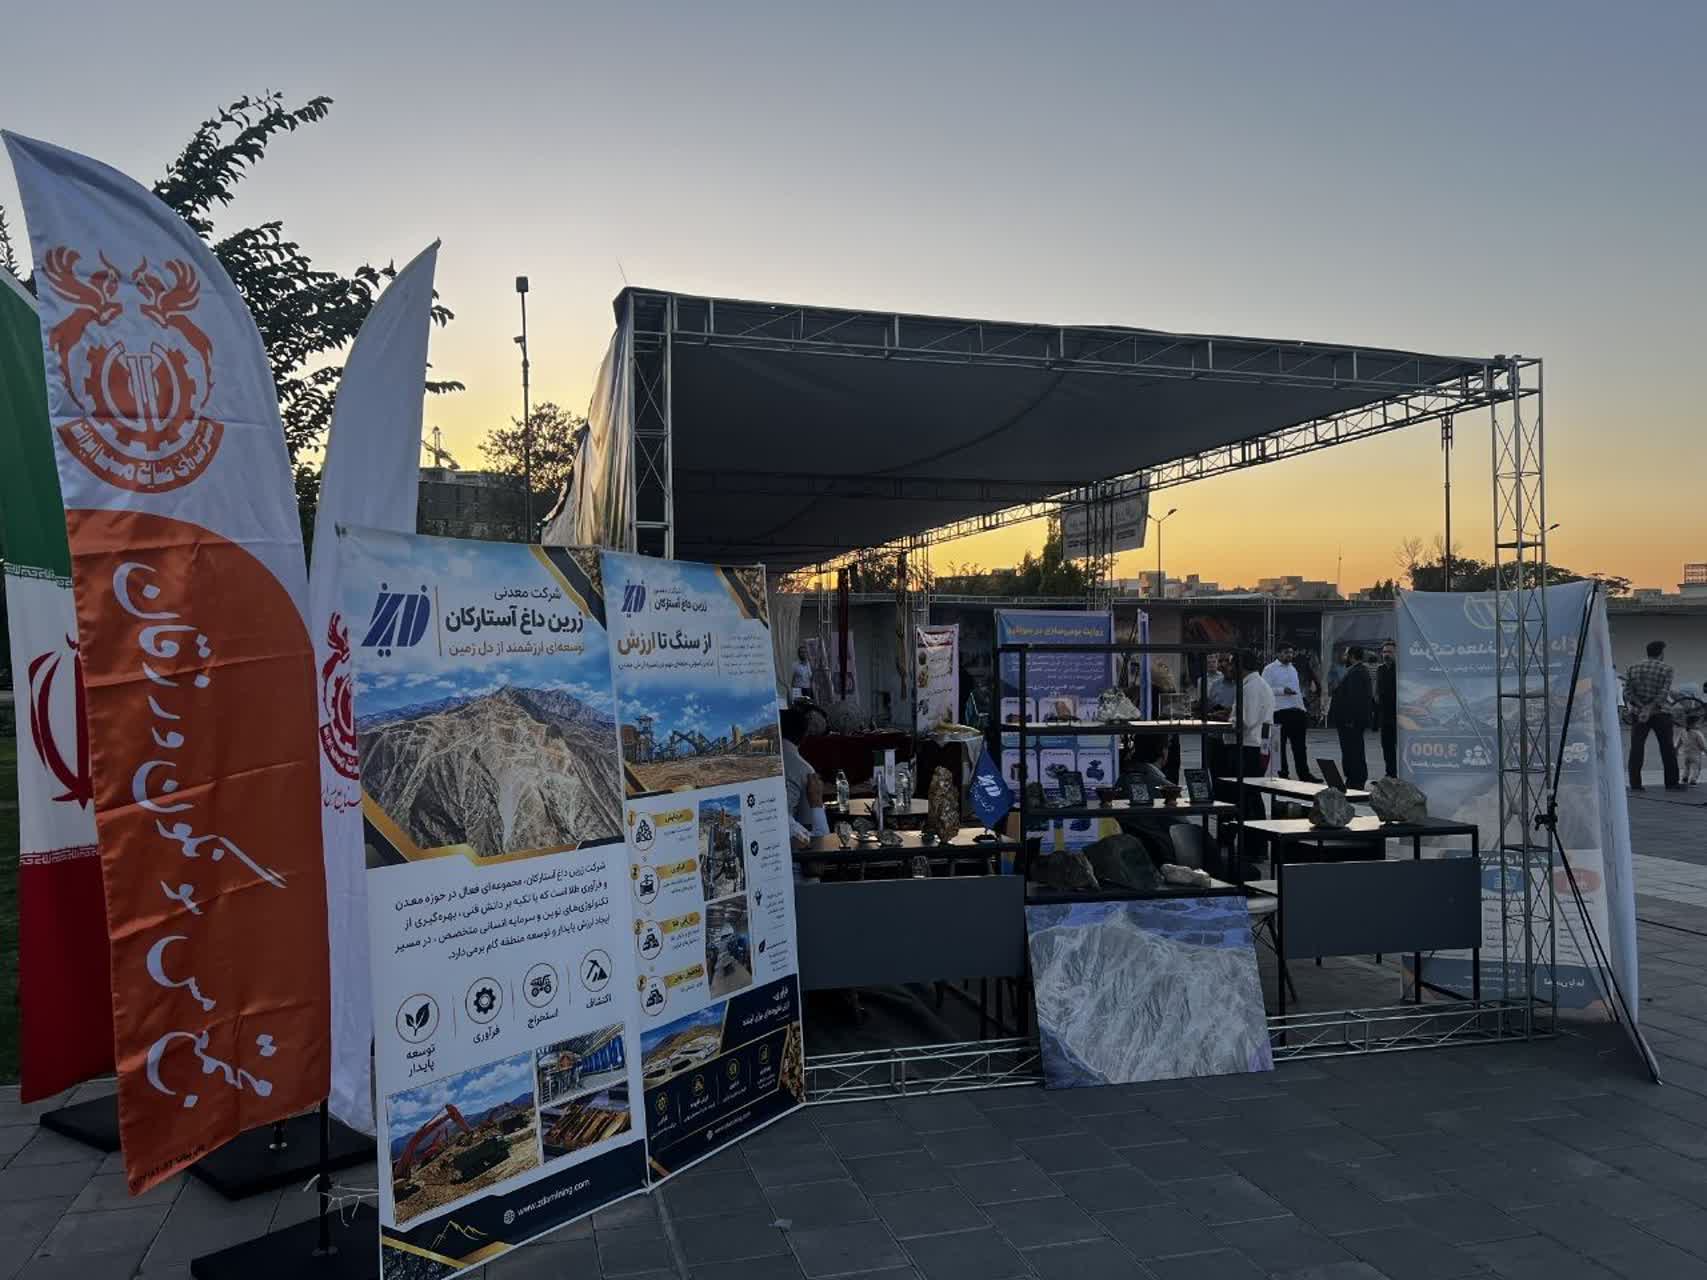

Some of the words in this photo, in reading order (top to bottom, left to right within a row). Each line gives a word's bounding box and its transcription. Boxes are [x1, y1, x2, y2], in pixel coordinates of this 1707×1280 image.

[494, 586, 529, 601] معدنی
[531, 587, 562, 602] شرکت
[445, 605, 518, 632] آستارکان
[520, 607, 546, 635] داغ
[548, 611, 584, 634] زرین
[617, 630, 656, 655] ارزش
[658, 631, 668, 649] تا
[669, 629, 700, 650] سنگ
[702, 631, 711, 655] از
[113, 561, 211, 749] ورزقان
[449, 642, 477, 656] زمین
[478, 641, 494, 656] دل
[496, 641, 504, 656] از
[506, 640, 543, 656] ارزشمند
[132, 760, 288, 915] سونگون
[557, 869, 567, 880] داغ
[569, 866, 584, 878] زرین
[585, 861, 606, 873] شرکت
[459, 885, 479, 899] فعال
[550, 887, 567, 897] است
[569, 885, 580, 894] طلا
[581, 879, 602, 894] فرآوری
[426, 893, 446, 905] حوزه
[448, 890, 457, 902] در
[513, 895, 532, 907] تکیه
[540, 890, 549, 899] که
[395, 897, 424, 911] معدن
[481, 901, 504, 914] دانش
[505, 900, 512, 911] بر
[509, 915, 536, 927] سرمایه
[542, 907, 561, 920] نوین
[595, 914, 610, 926] ایجاد
[405, 916, 412, 931] از
[480, 918, 506, 934] انسانی
[557, 922, 575, 937] پایدار
[577, 918, 595, 932] ارزش
[500, 935, 525, 946] منطقه
[526, 928, 550, 940] توسعه
[394, 940, 421, 954] مسیر
[422, 936, 432, 948] در
[486, 938, 498, 953] گام
[146, 935, 216, 1011] مس
[527, 1008, 558, 1029] استخراج
[472, 1025, 500, 1044] فرآوری
[406, 1044, 436, 1060] توسعه
[146, 1030, 278, 1108] مجتمع
[408, 1060, 435, 1078] پایدار
